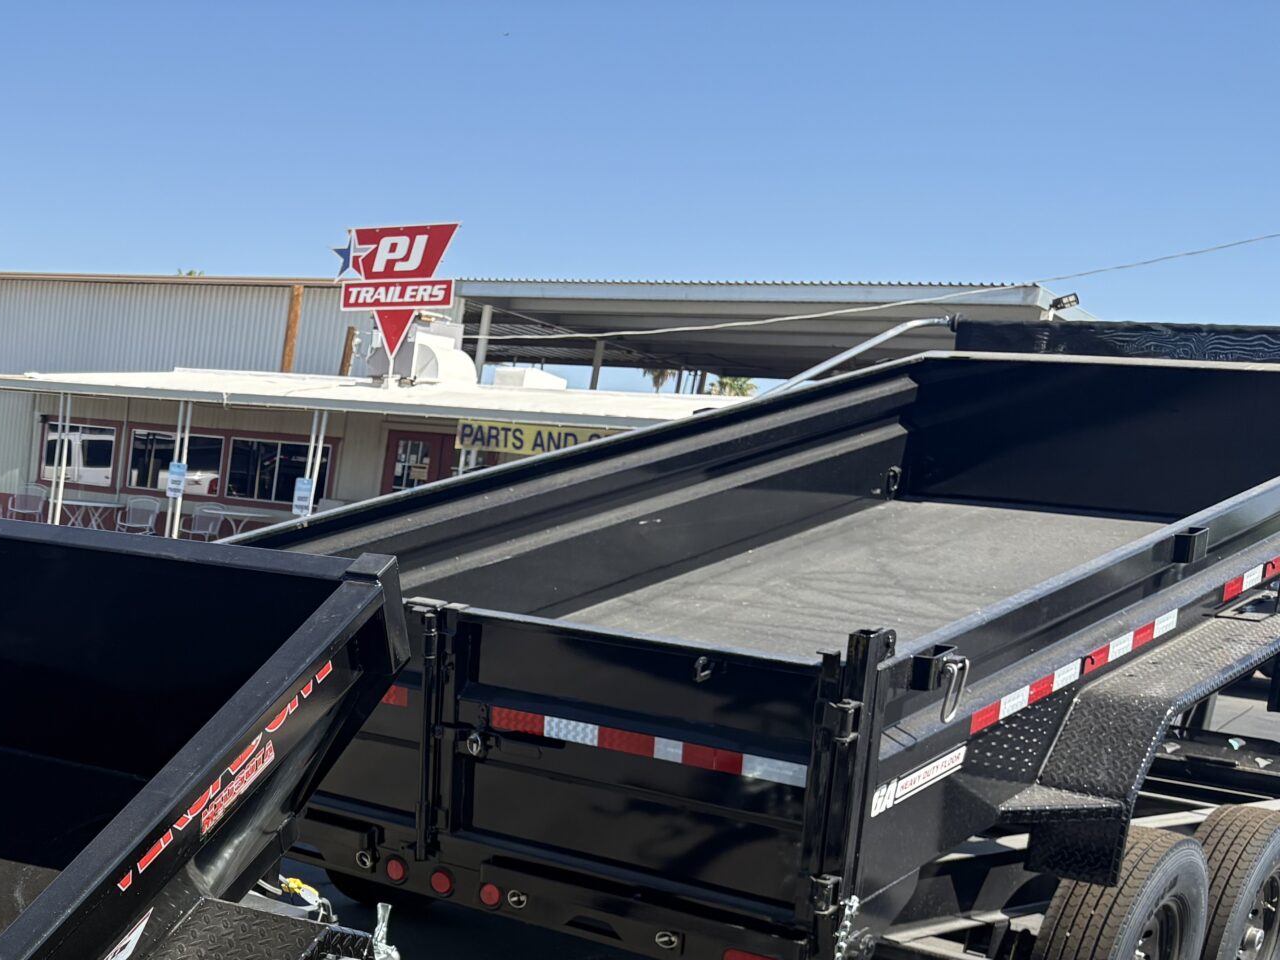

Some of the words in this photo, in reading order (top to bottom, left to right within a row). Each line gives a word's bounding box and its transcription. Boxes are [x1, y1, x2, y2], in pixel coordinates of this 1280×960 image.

[371, 234, 430, 273] PJ
[348, 284, 448, 304] TRAILERS
[459, 423, 525, 450] PARTS
[532, 430, 579, 452] AND
